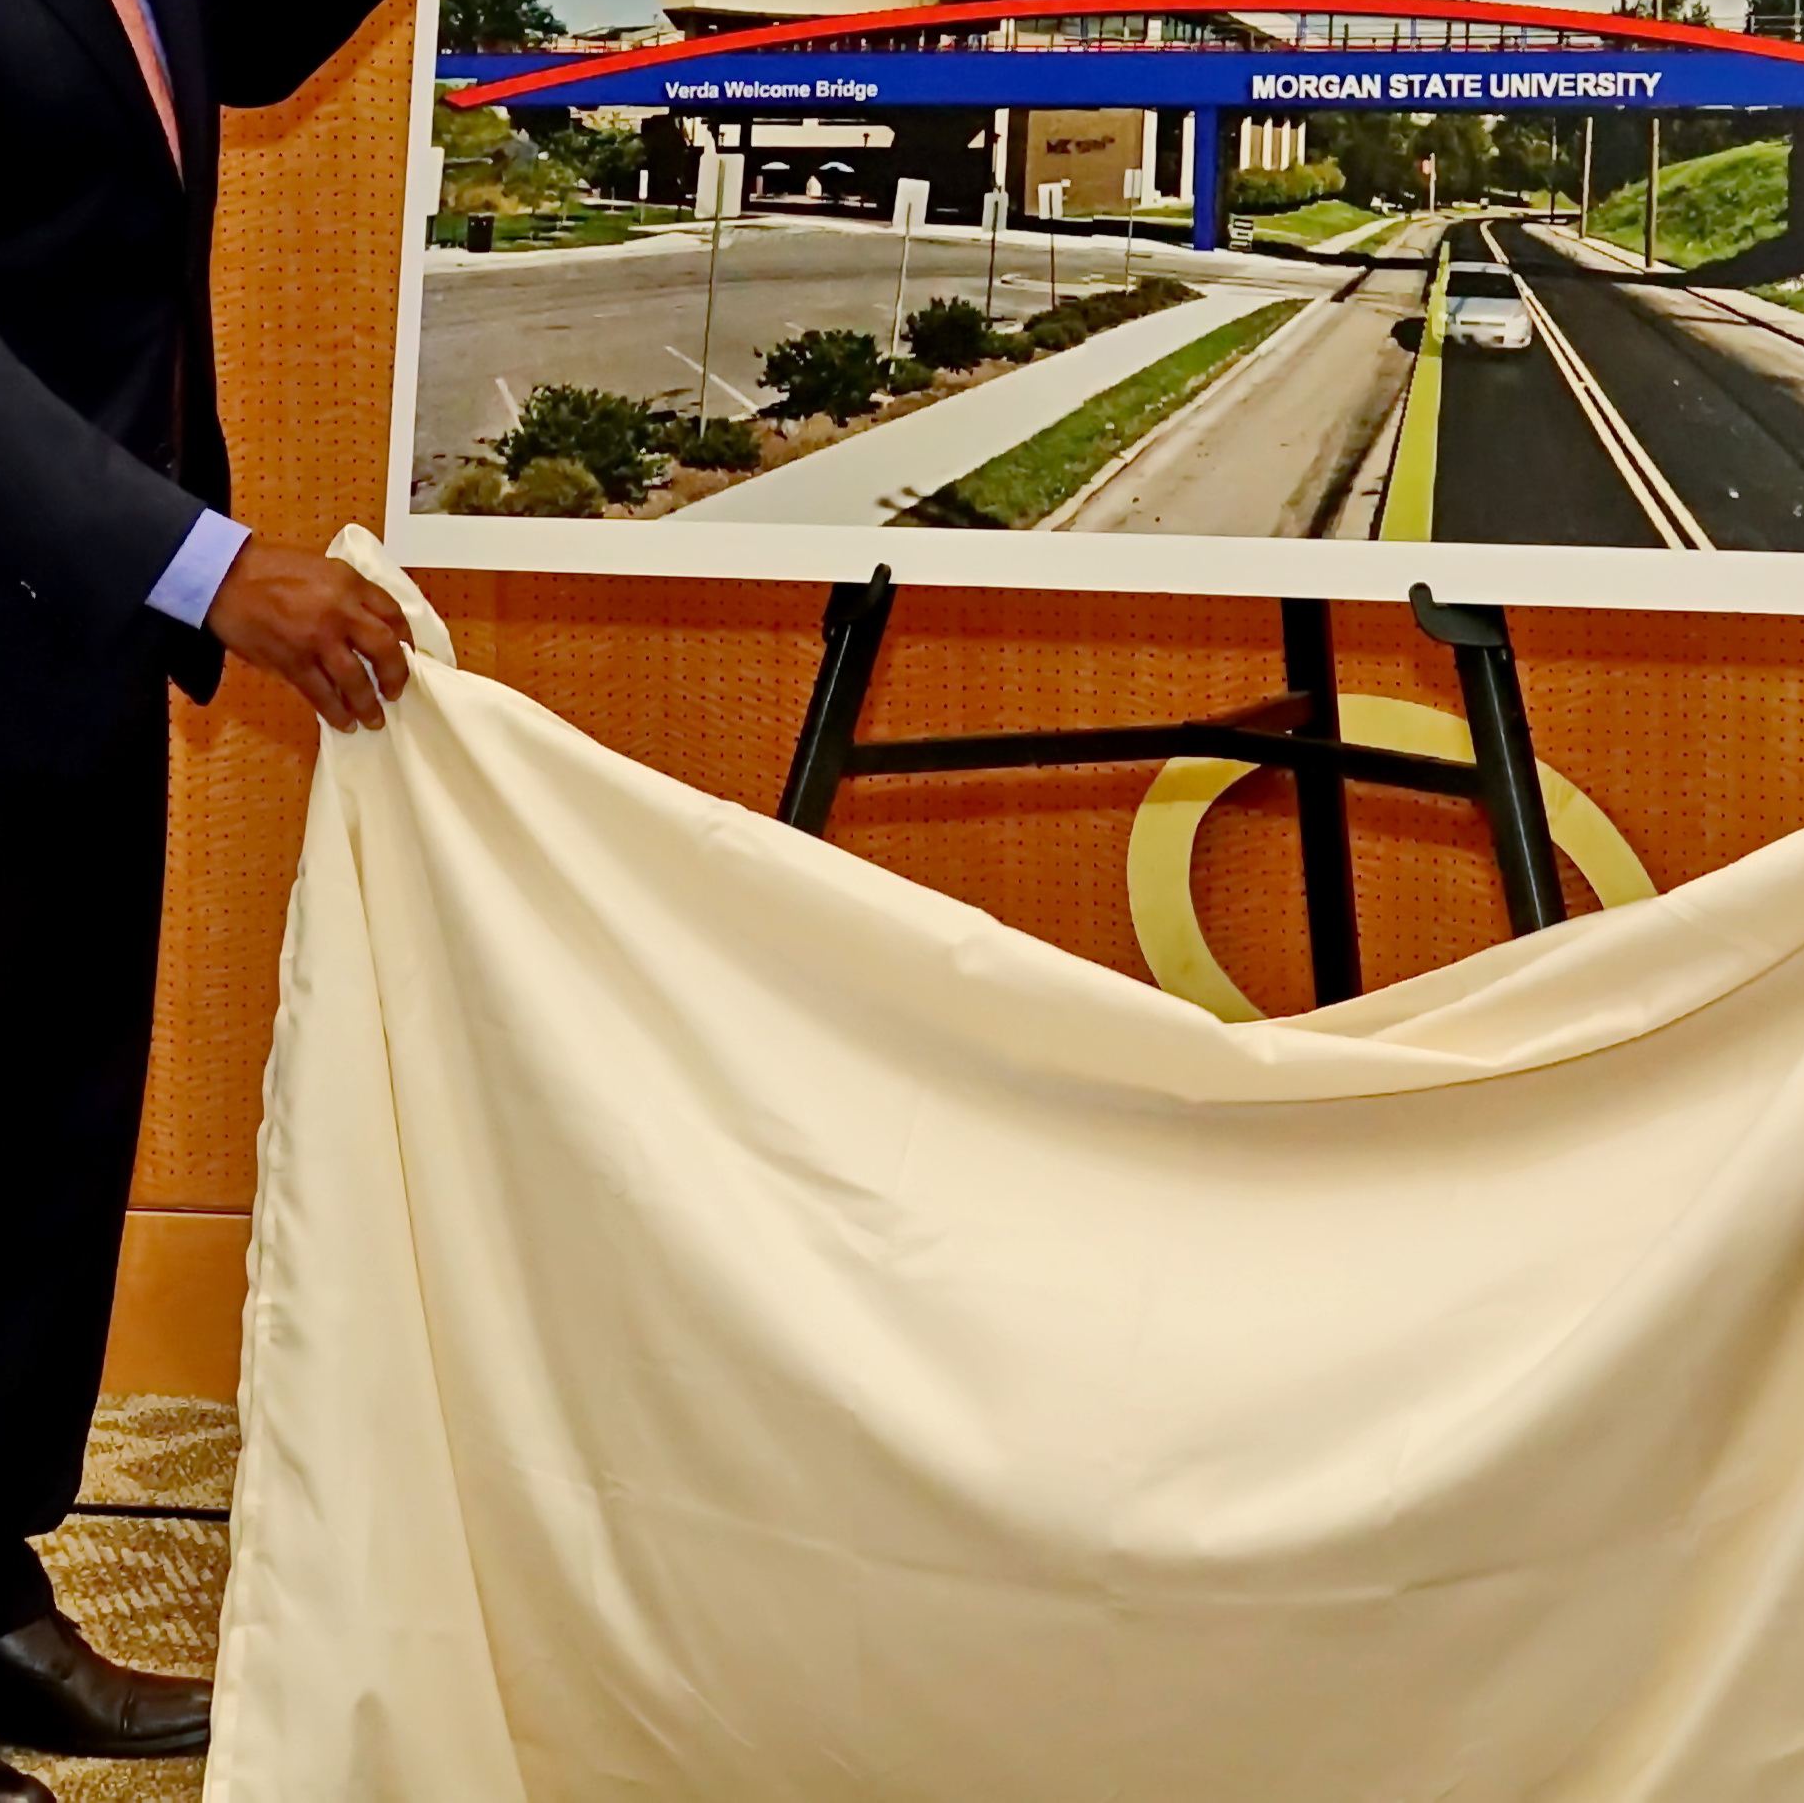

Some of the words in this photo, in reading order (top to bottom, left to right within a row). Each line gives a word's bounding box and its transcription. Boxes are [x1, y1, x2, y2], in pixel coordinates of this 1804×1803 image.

[665, 81, 720, 100] Verda
[723, 80, 812, 99] Welcome
[815, 78, 879, 102] Bridge
[1252, 74, 1382, 100] MORGAN
[1388, 73, 1483, 99] STATE
[1489, 71, 1663, 99] UNIVERSITY
